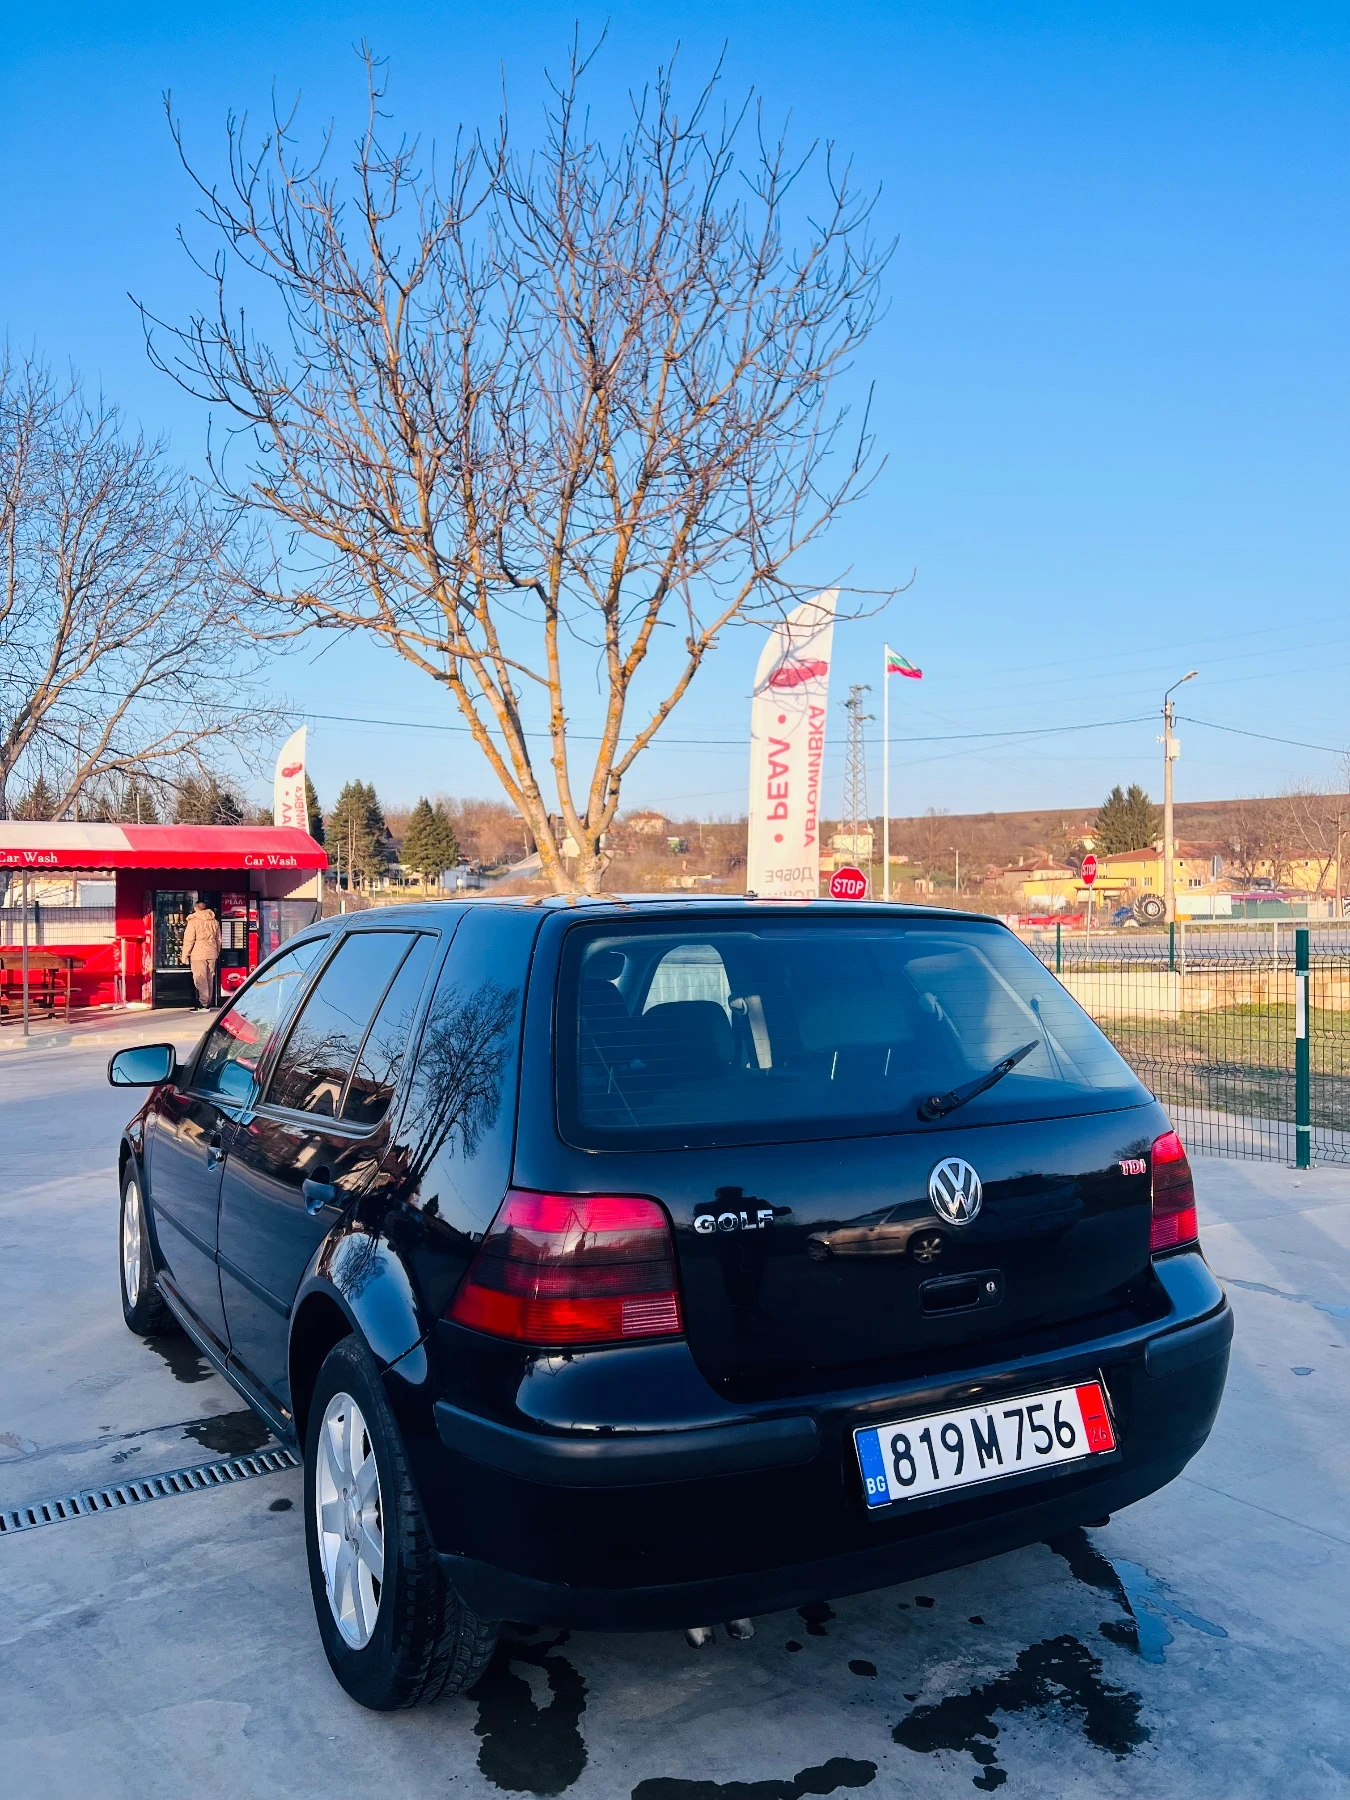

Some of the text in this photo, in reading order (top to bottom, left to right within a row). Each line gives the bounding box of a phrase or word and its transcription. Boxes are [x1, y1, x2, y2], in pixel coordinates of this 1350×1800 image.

[0, 851, 59, 863] Car Wash
[244, 854, 297, 866] Car Wash
[1083, 864, 1095, 876] STOP
[832, 878, 865, 895] STOP
[1118, 1158, 1147, 1176] TDI
[693, 1209, 774, 1235] GOLF
[1090, 1426, 1108, 1443] 26
[866, 1474, 887, 1495] BG
